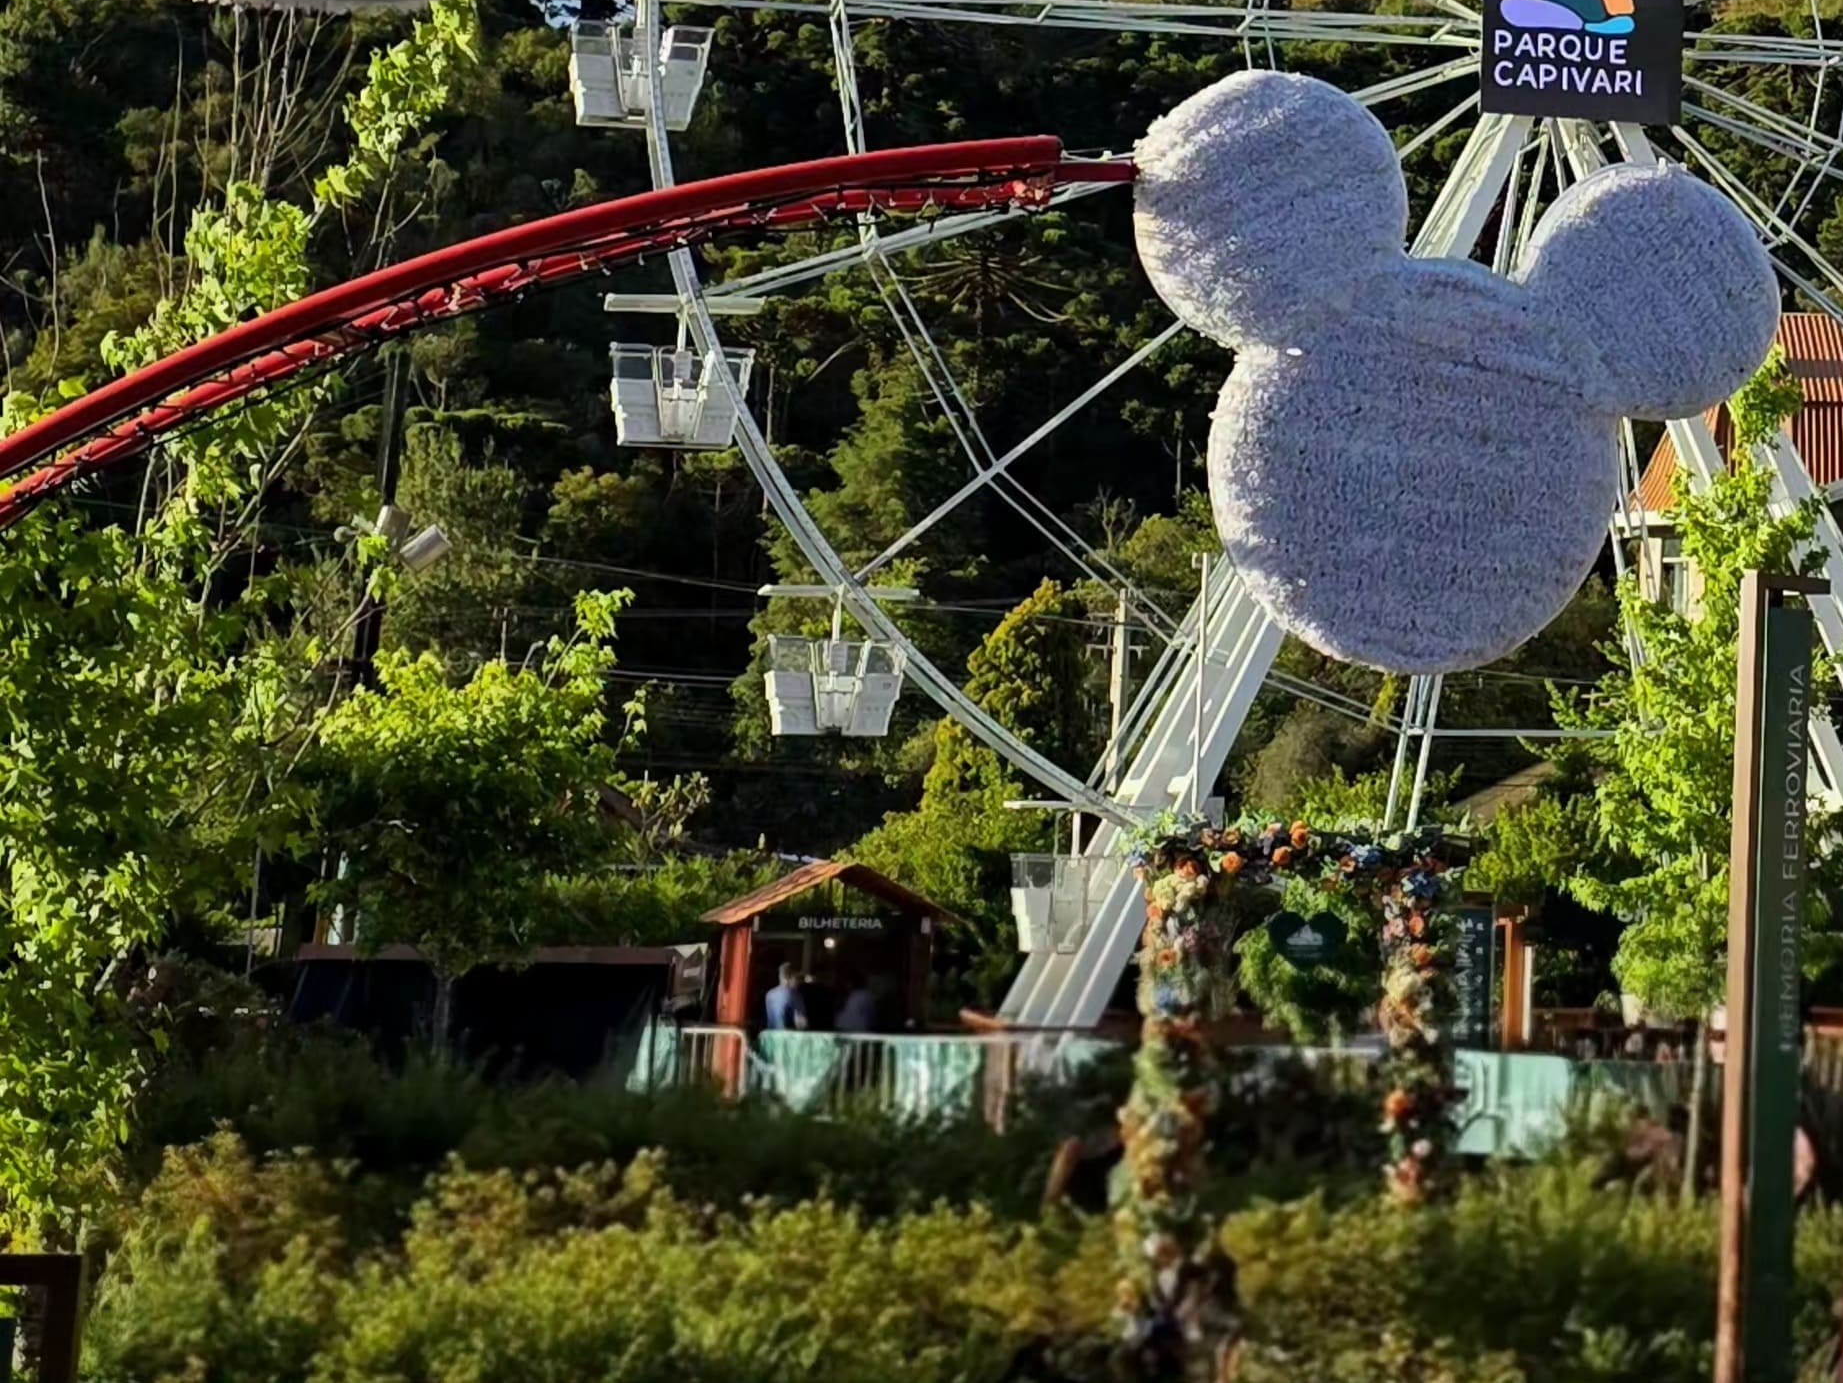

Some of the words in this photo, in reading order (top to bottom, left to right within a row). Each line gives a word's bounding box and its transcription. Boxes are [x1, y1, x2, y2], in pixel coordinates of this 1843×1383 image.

[1494, 30, 1627, 64] PARQUE
[1494, 61, 1642, 95] CAPIVARI
[1782, 664, 1805, 880] FERROVIARIA
[798, 917, 882, 929] BILHETERIA
